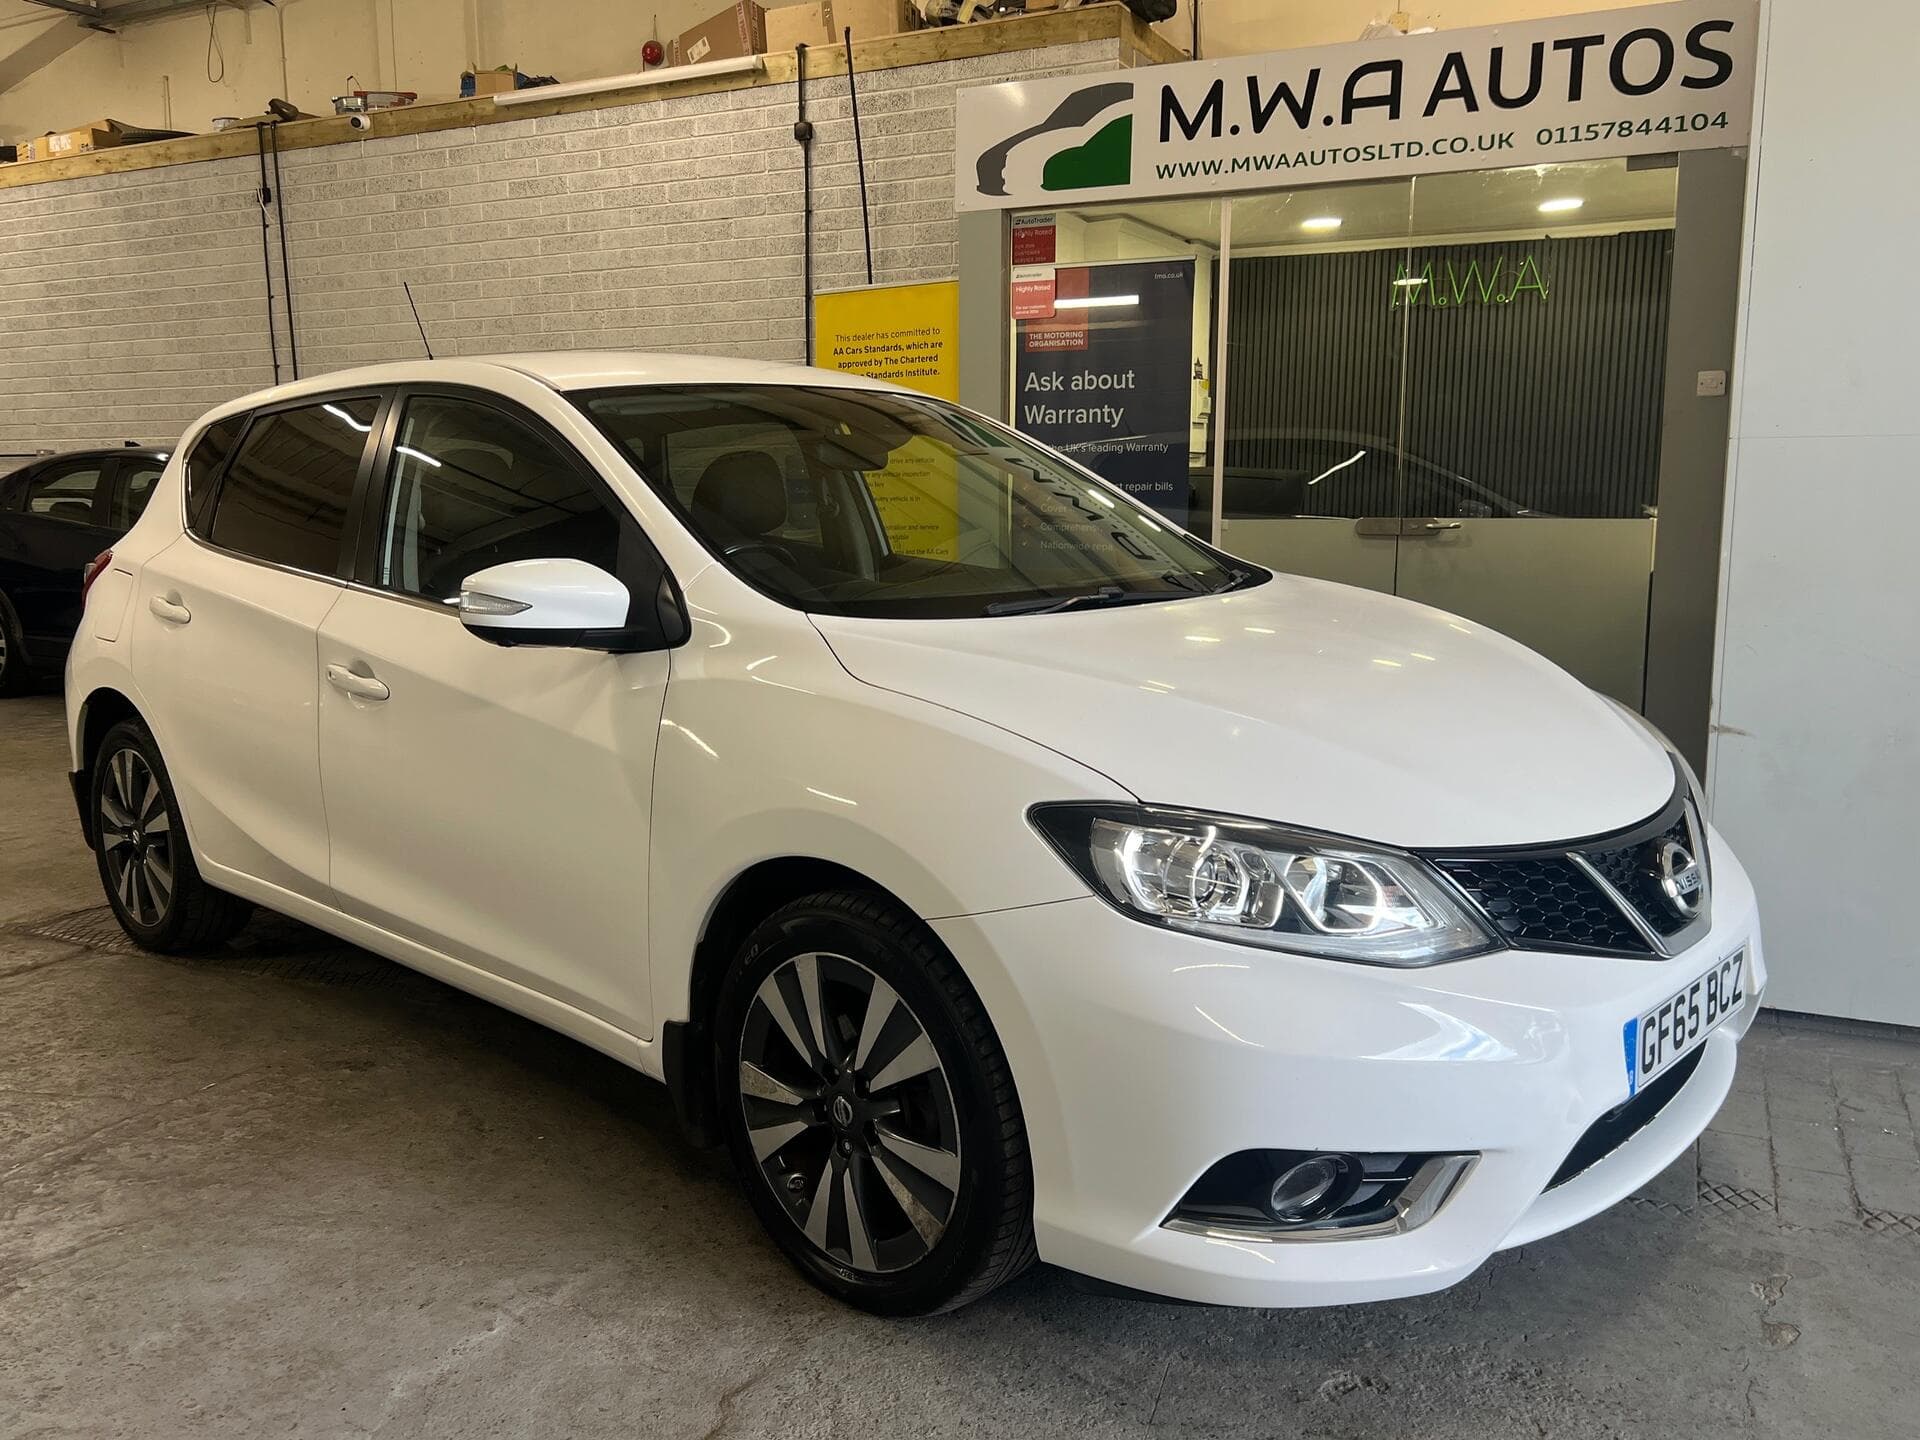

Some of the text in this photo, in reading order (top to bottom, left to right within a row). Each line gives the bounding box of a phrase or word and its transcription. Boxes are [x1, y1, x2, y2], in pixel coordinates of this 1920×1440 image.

[1159, 20, 1735, 143] M.W.A AUTOS
[1156, 111, 1729, 180] WWW.MWAAUTOSLTD.CO.UK 01157844104
[1391, 255, 1547, 309] M.W.A
[835, 327, 941, 342] This dealer has committed to
[1044, 331, 1084, 339] MOTORING
[833, 347, 844, 356] AA
[845, 346, 863, 355] Cars
[905, 340, 929, 351] which
[930, 340, 943, 349] are
[1029, 338, 1084, 348] ORGANISATION
[837, 353, 939, 369] approved by The Chartered
[866, 367, 940, 379] Standards Institute.
[1024, 369, 1136, 392] Ask about
[1024, 404, 1125, 428] Warranty
[1089, 443, 1123, 454] leading
[1125, 442, 1169, 453] Warranty
[1125, 482, 1152, 492] repair
[1155, 482, 1174, 491] bills
[1641, 949, 1744, 1075] GF65 BCZ
